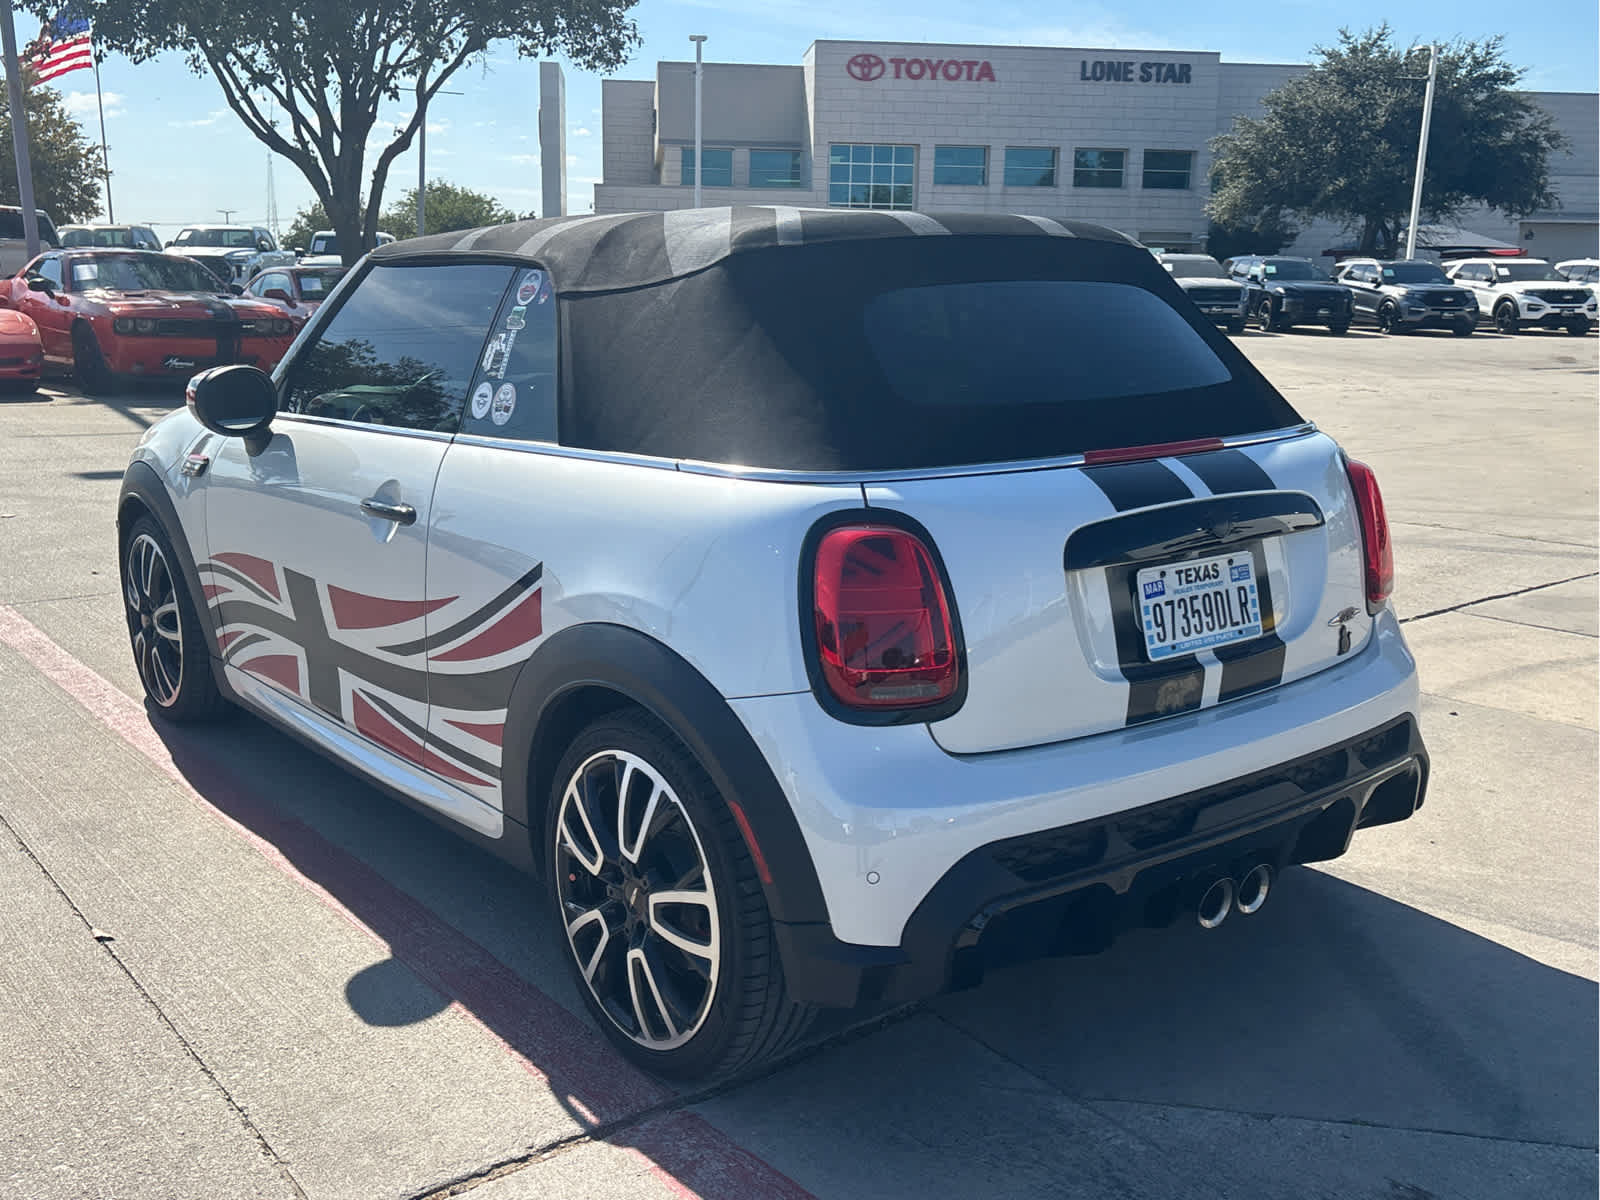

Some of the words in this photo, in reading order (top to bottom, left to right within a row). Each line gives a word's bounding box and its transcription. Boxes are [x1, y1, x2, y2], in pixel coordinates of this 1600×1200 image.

[889, 58, 996, 82] TOYOTA
[1080, 60, 1134, 82] LONE
[1139, 62, 1191, 84] STAR
[1175, 563, 1220, 586] TEXAS
[1145, 581, 1164, 595] MAR
[1152, 586, 1251, 643] 97359DLR
